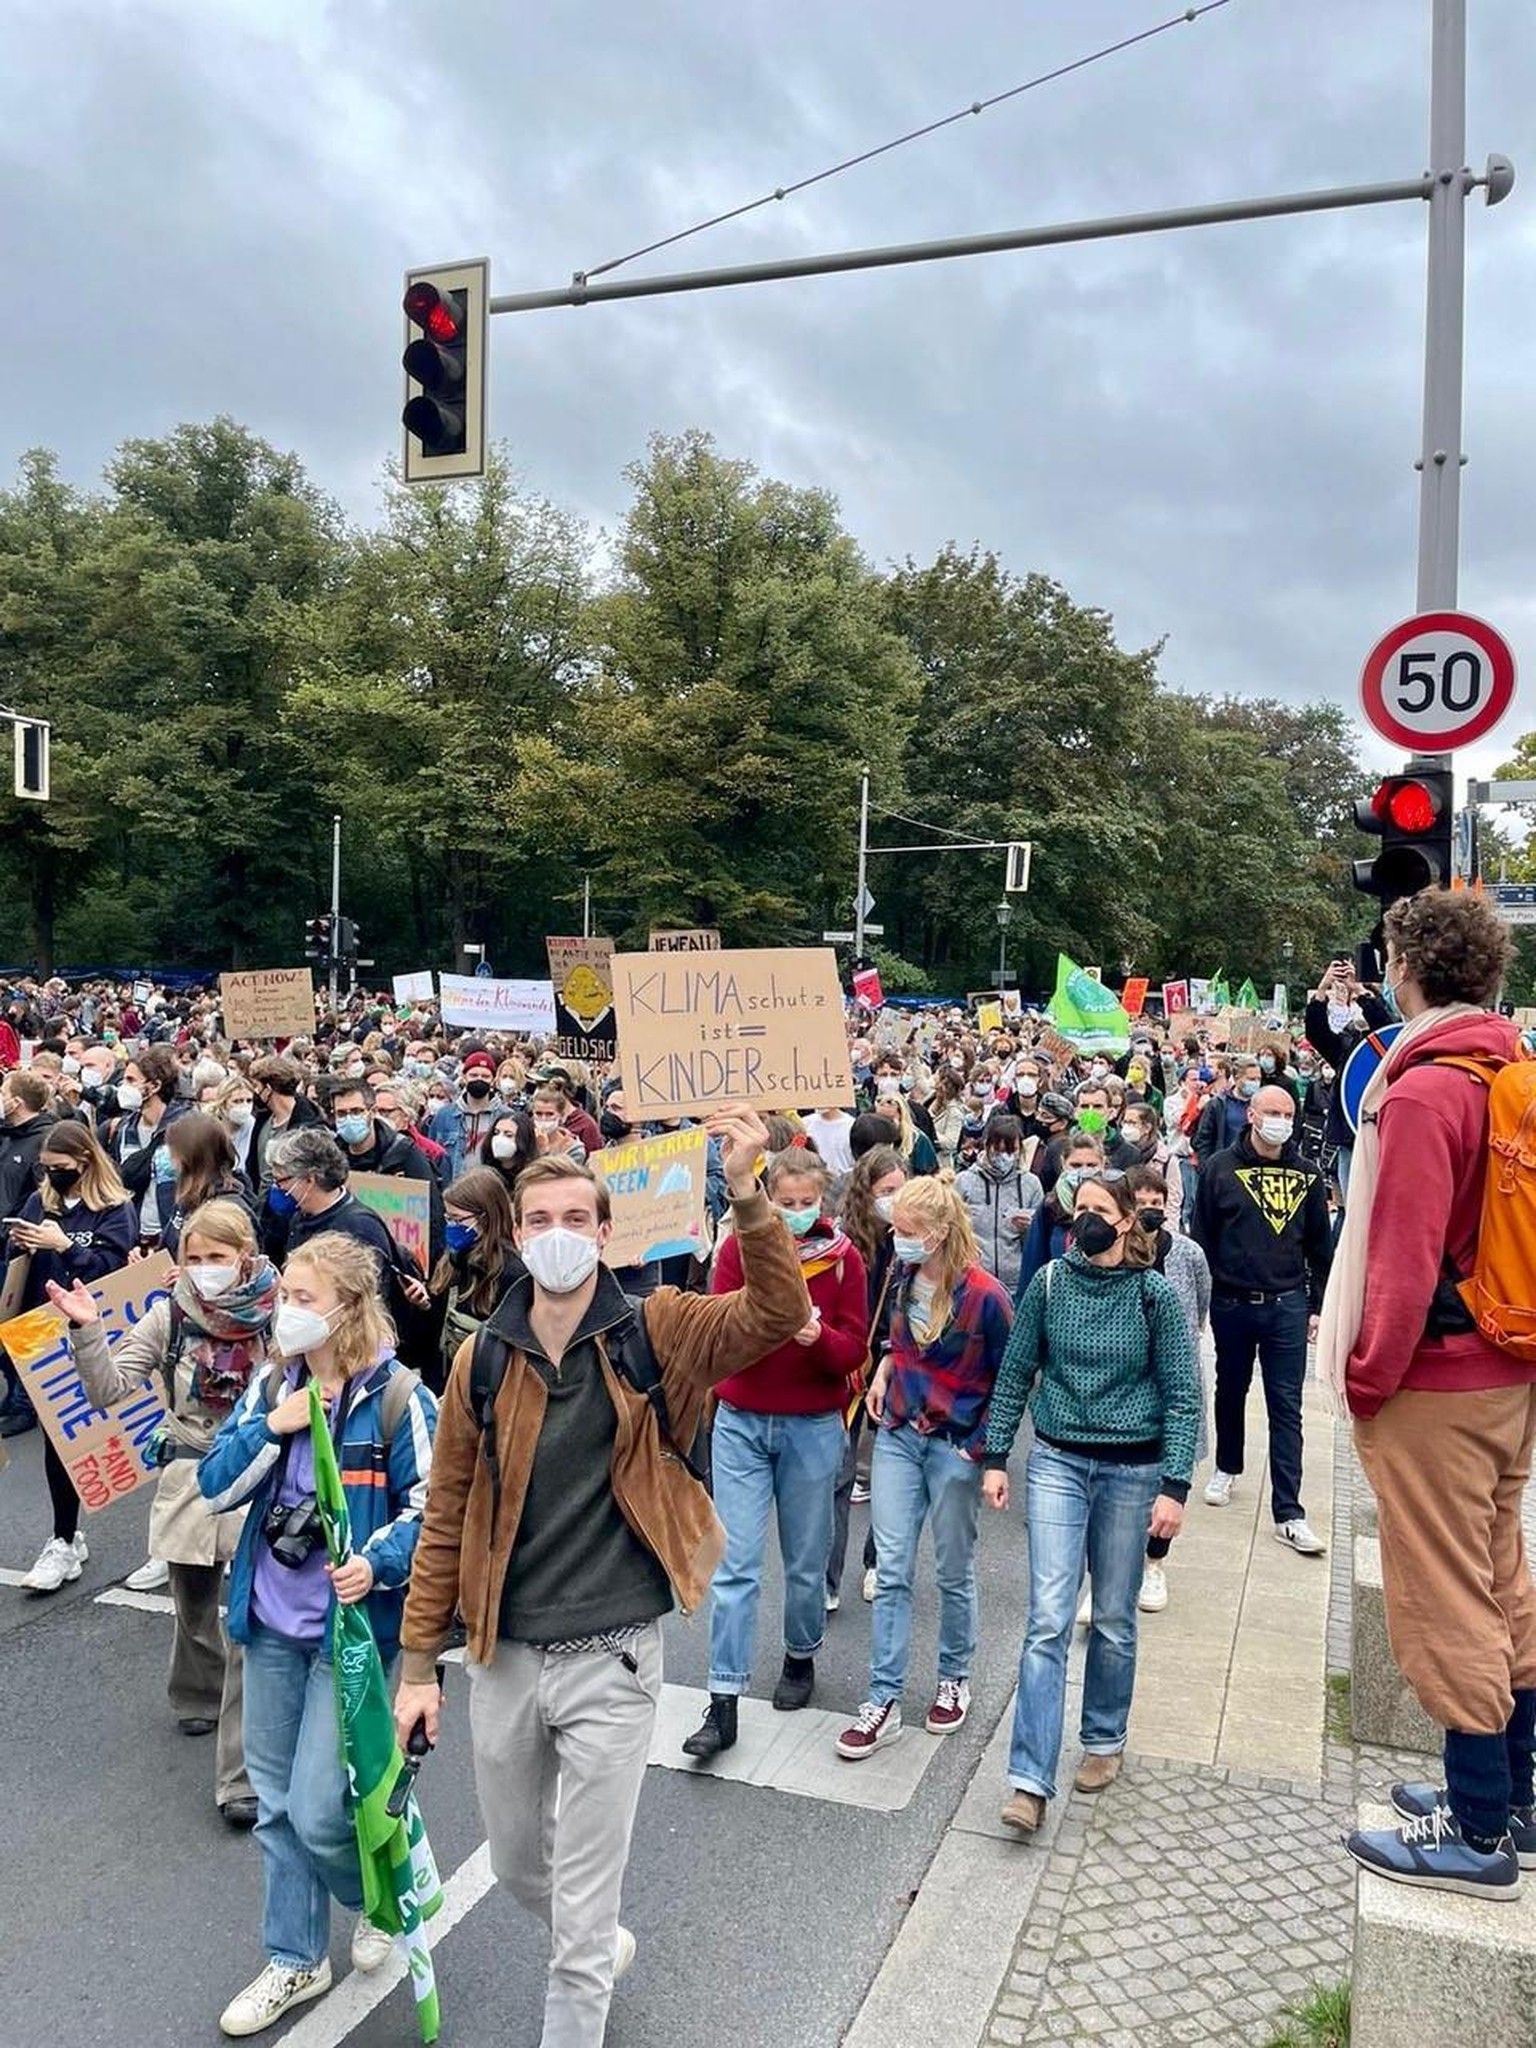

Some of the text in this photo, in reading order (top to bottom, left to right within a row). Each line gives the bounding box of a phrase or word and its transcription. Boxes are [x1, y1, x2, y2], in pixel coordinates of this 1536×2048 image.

[1397, 651, 1481, 713] 50
[230, 976, 257, 988] ACT
[559, 1035, 614, 1059] GELDSAC
[645, 1129, 705, 1164] WERDEN
[29, 1336, 109, 1441] TIME
[72, 1454, 110, 1507] FOOD
